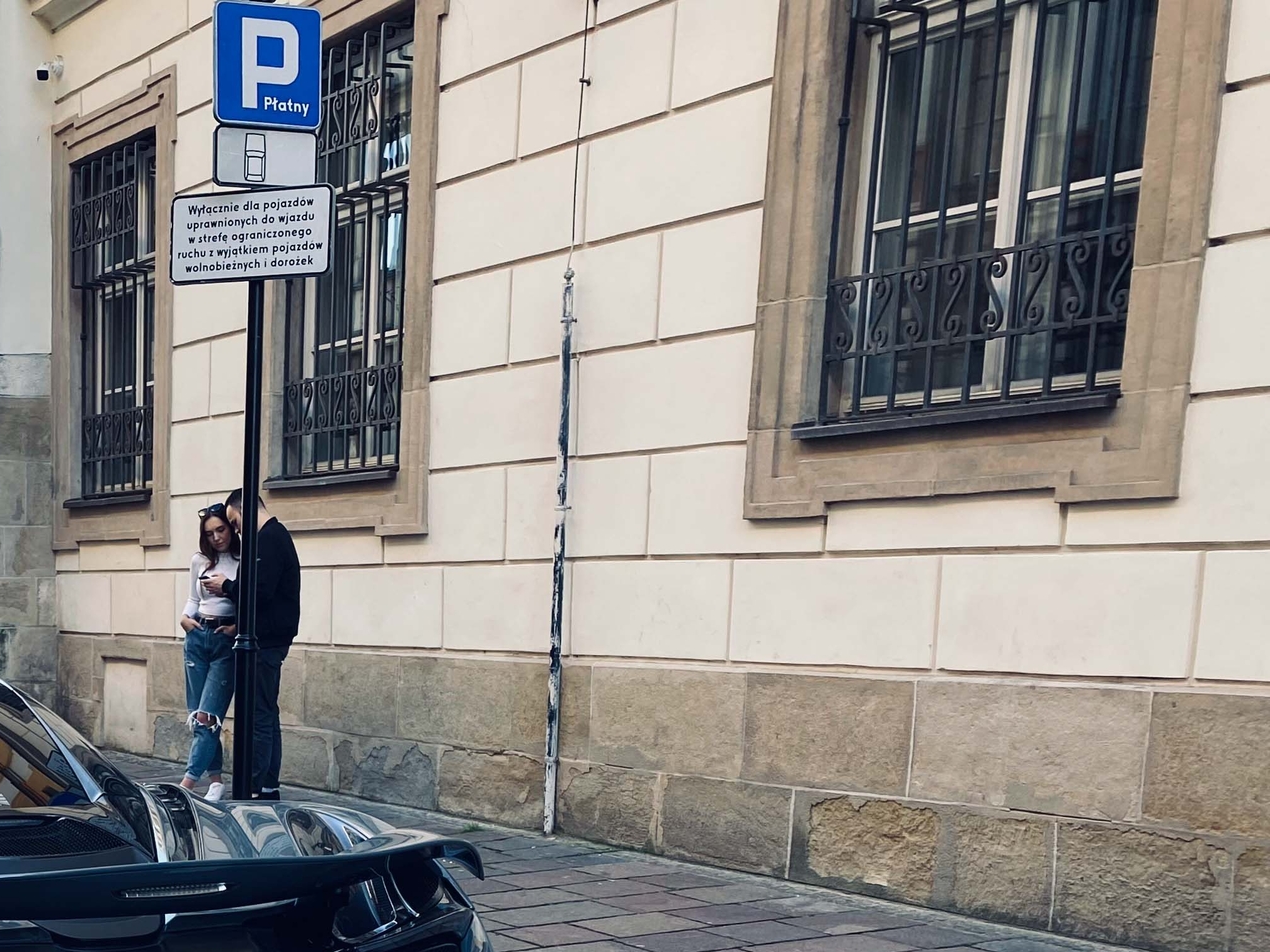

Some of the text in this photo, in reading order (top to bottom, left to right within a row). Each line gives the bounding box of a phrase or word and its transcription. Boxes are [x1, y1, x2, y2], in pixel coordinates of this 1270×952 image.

[241, 17, 300, 109] P
[263, 96, 310, 117] Płatny
[188, 197, 315, 217] Wyłącznie dla pojazdów
[187, 211, 315, 232] uprawnionych do wjazdu
[188, 228, 312, 244] w strefę ograniczonego
[177, 248, 206, 259] ruchu
[217, 244, 269, 258] wyjątkiem
[272, 240, 323, 256] pojazdów
[185, 259, 261, 273] wolnobieżnych
[270, 255, 314, 268] dorożek
